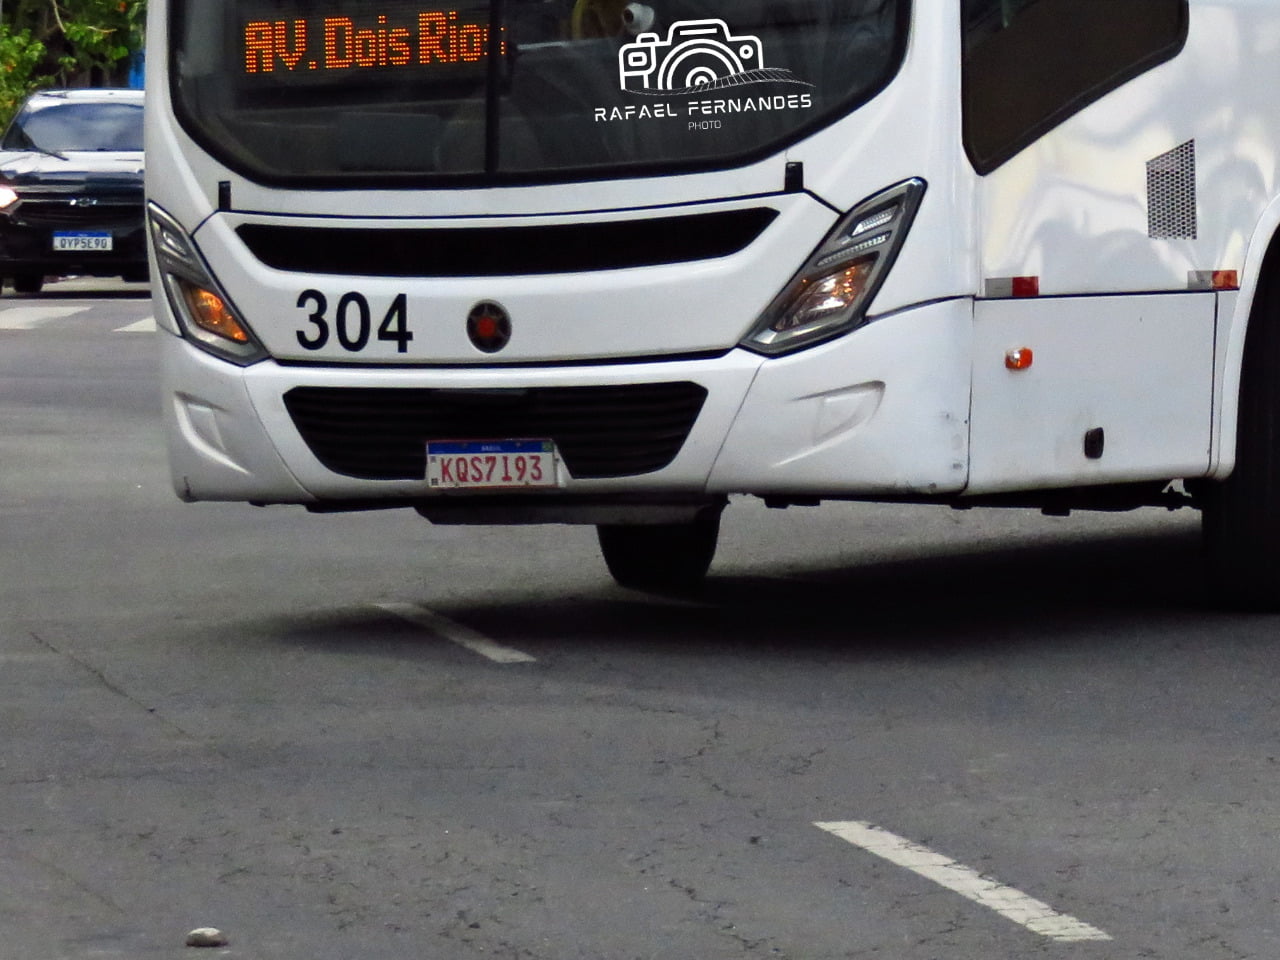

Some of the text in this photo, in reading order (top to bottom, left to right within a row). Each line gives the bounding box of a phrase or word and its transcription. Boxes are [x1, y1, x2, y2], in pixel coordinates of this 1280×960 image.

[246, 19, 317, 73] AV.
[325, 15, 410, 69] Dois
[296, 289, 414, 353] 304
